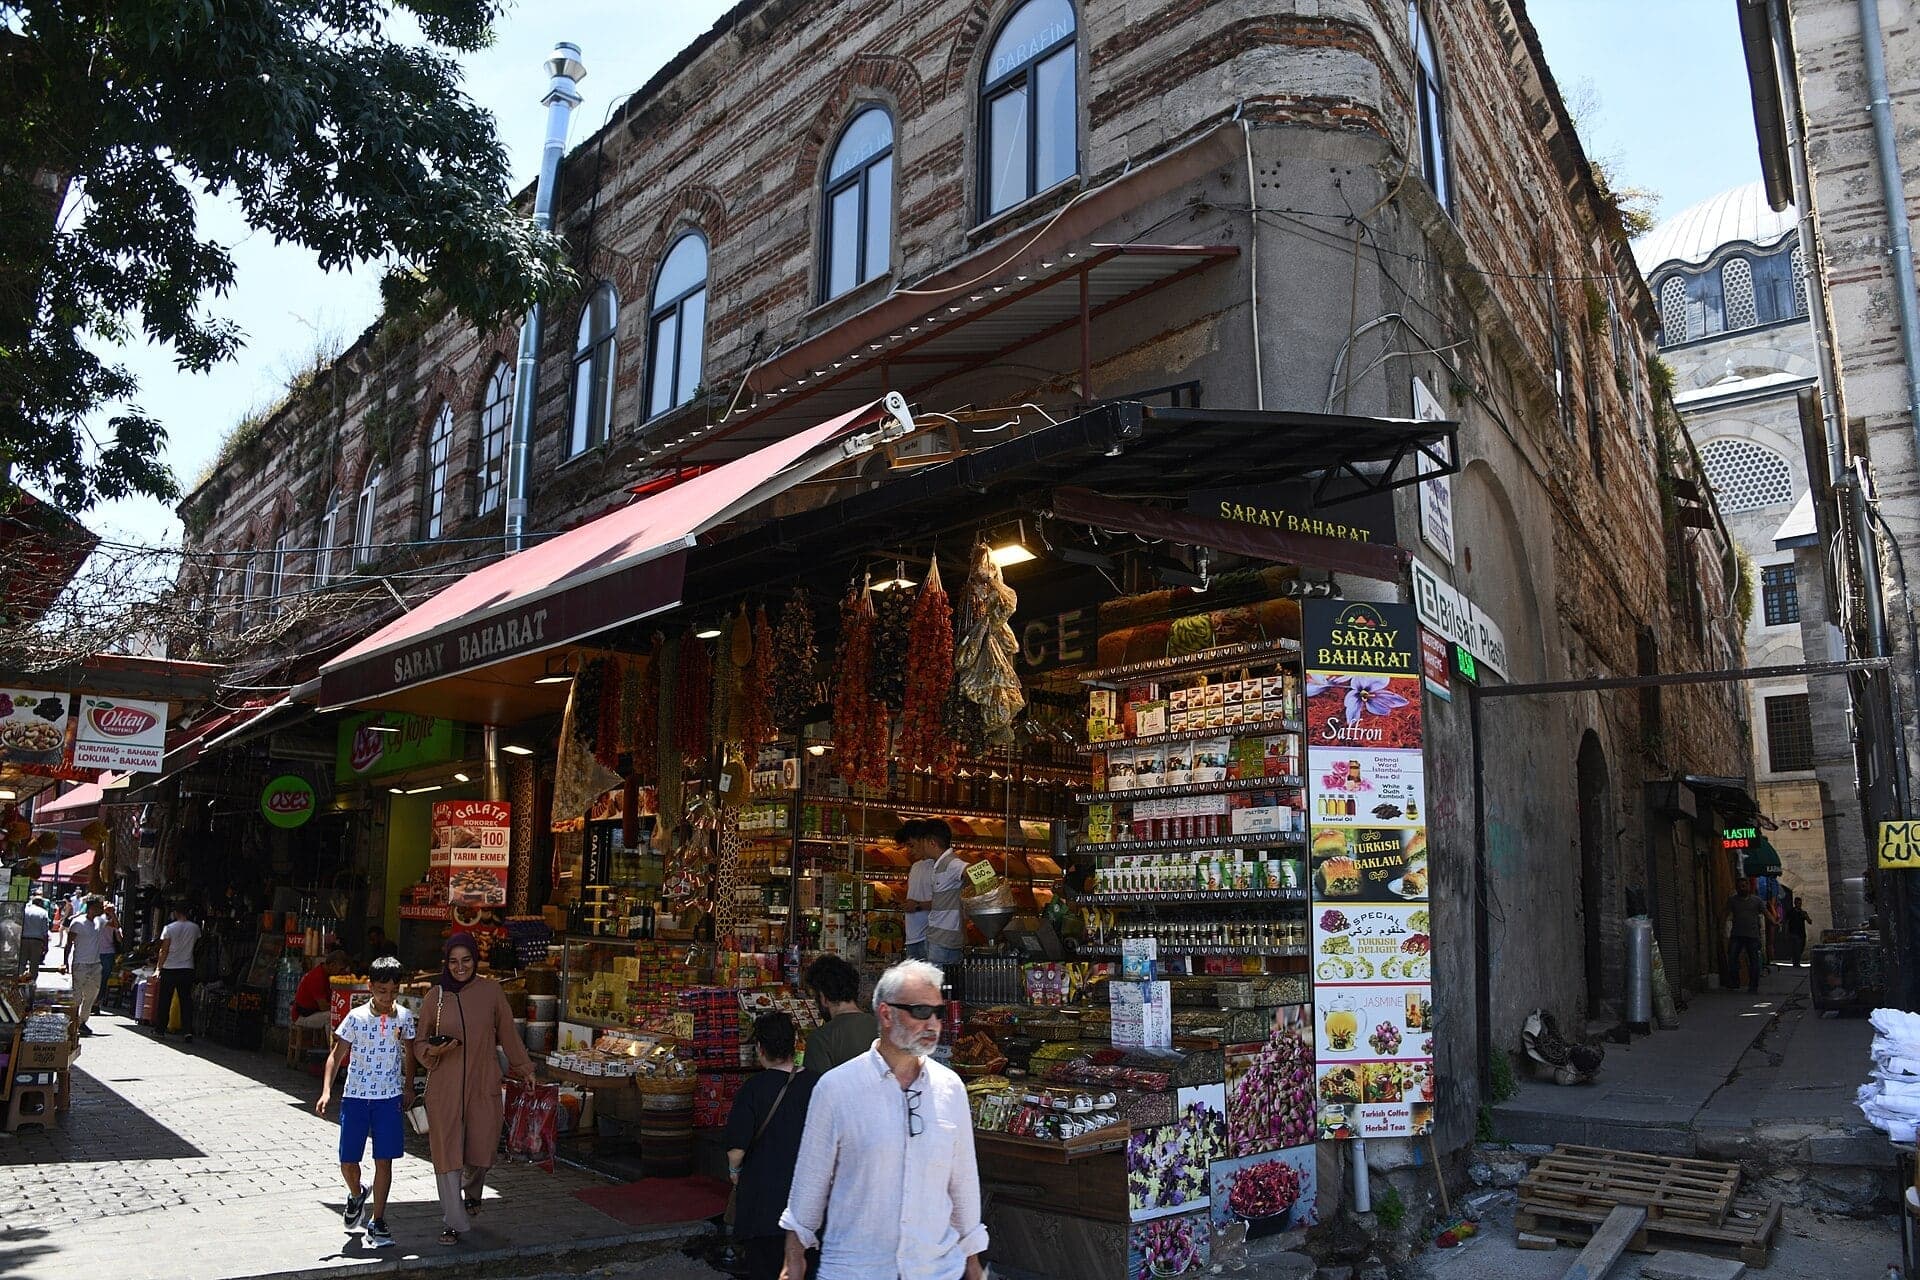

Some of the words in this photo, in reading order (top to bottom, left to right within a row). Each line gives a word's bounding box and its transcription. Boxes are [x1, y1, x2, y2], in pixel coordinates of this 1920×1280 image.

[1220, 501, 1285, 529] SARAY
[1288, 515, 1370, 543] BAHARAT
[1439, 594, 1477, 650] Bilsan
[394, 642, 444, 684] SARAY
[459, 609, 548, 664] BAHARAT
[1331, 630, 1398, 649] SARAY
[1317, 649, 1411, 669] BAHARAT
[101, 710, 148, 732] Oktay
[1322, 717, 1382, 742] Saffron
[79, 744, 120, 755] KURUYEMİŞ
[127, 748, 159, 757] BAHARAT
[78, 754, 110, 763] LOKUM
[120, 757, 157, 767] BAKLAVA
[455, 803, 508, 821] GALATA
[464, 819, 498, 827] KOKOREÇ
[483, 832, 503, 846] 100
[1352, 838, 1400, 854] TURKISH
[453, 853, 477, 861] YARIM
[480, 853, 506, 861] EKMEK
[590, 834, 598, 882] GALATA
[1353, 855, 1403, 869] BAKLAVA
[1353, 912, 1400, 926] SPECIAL
[1357, 937, 1397, 946] TURKISH
[1358, 946, 1398, 954] DELIGHT
[1364, 996, 1404, 1009] JASMINE
[1361, 1109, 1386, 1118] Turkish
[1387, 1109, 1409, 1118] Coffee
[1365, 1124, 1390, 1133] Herbal
[1391, 1124, 1406, 1132] Teas
